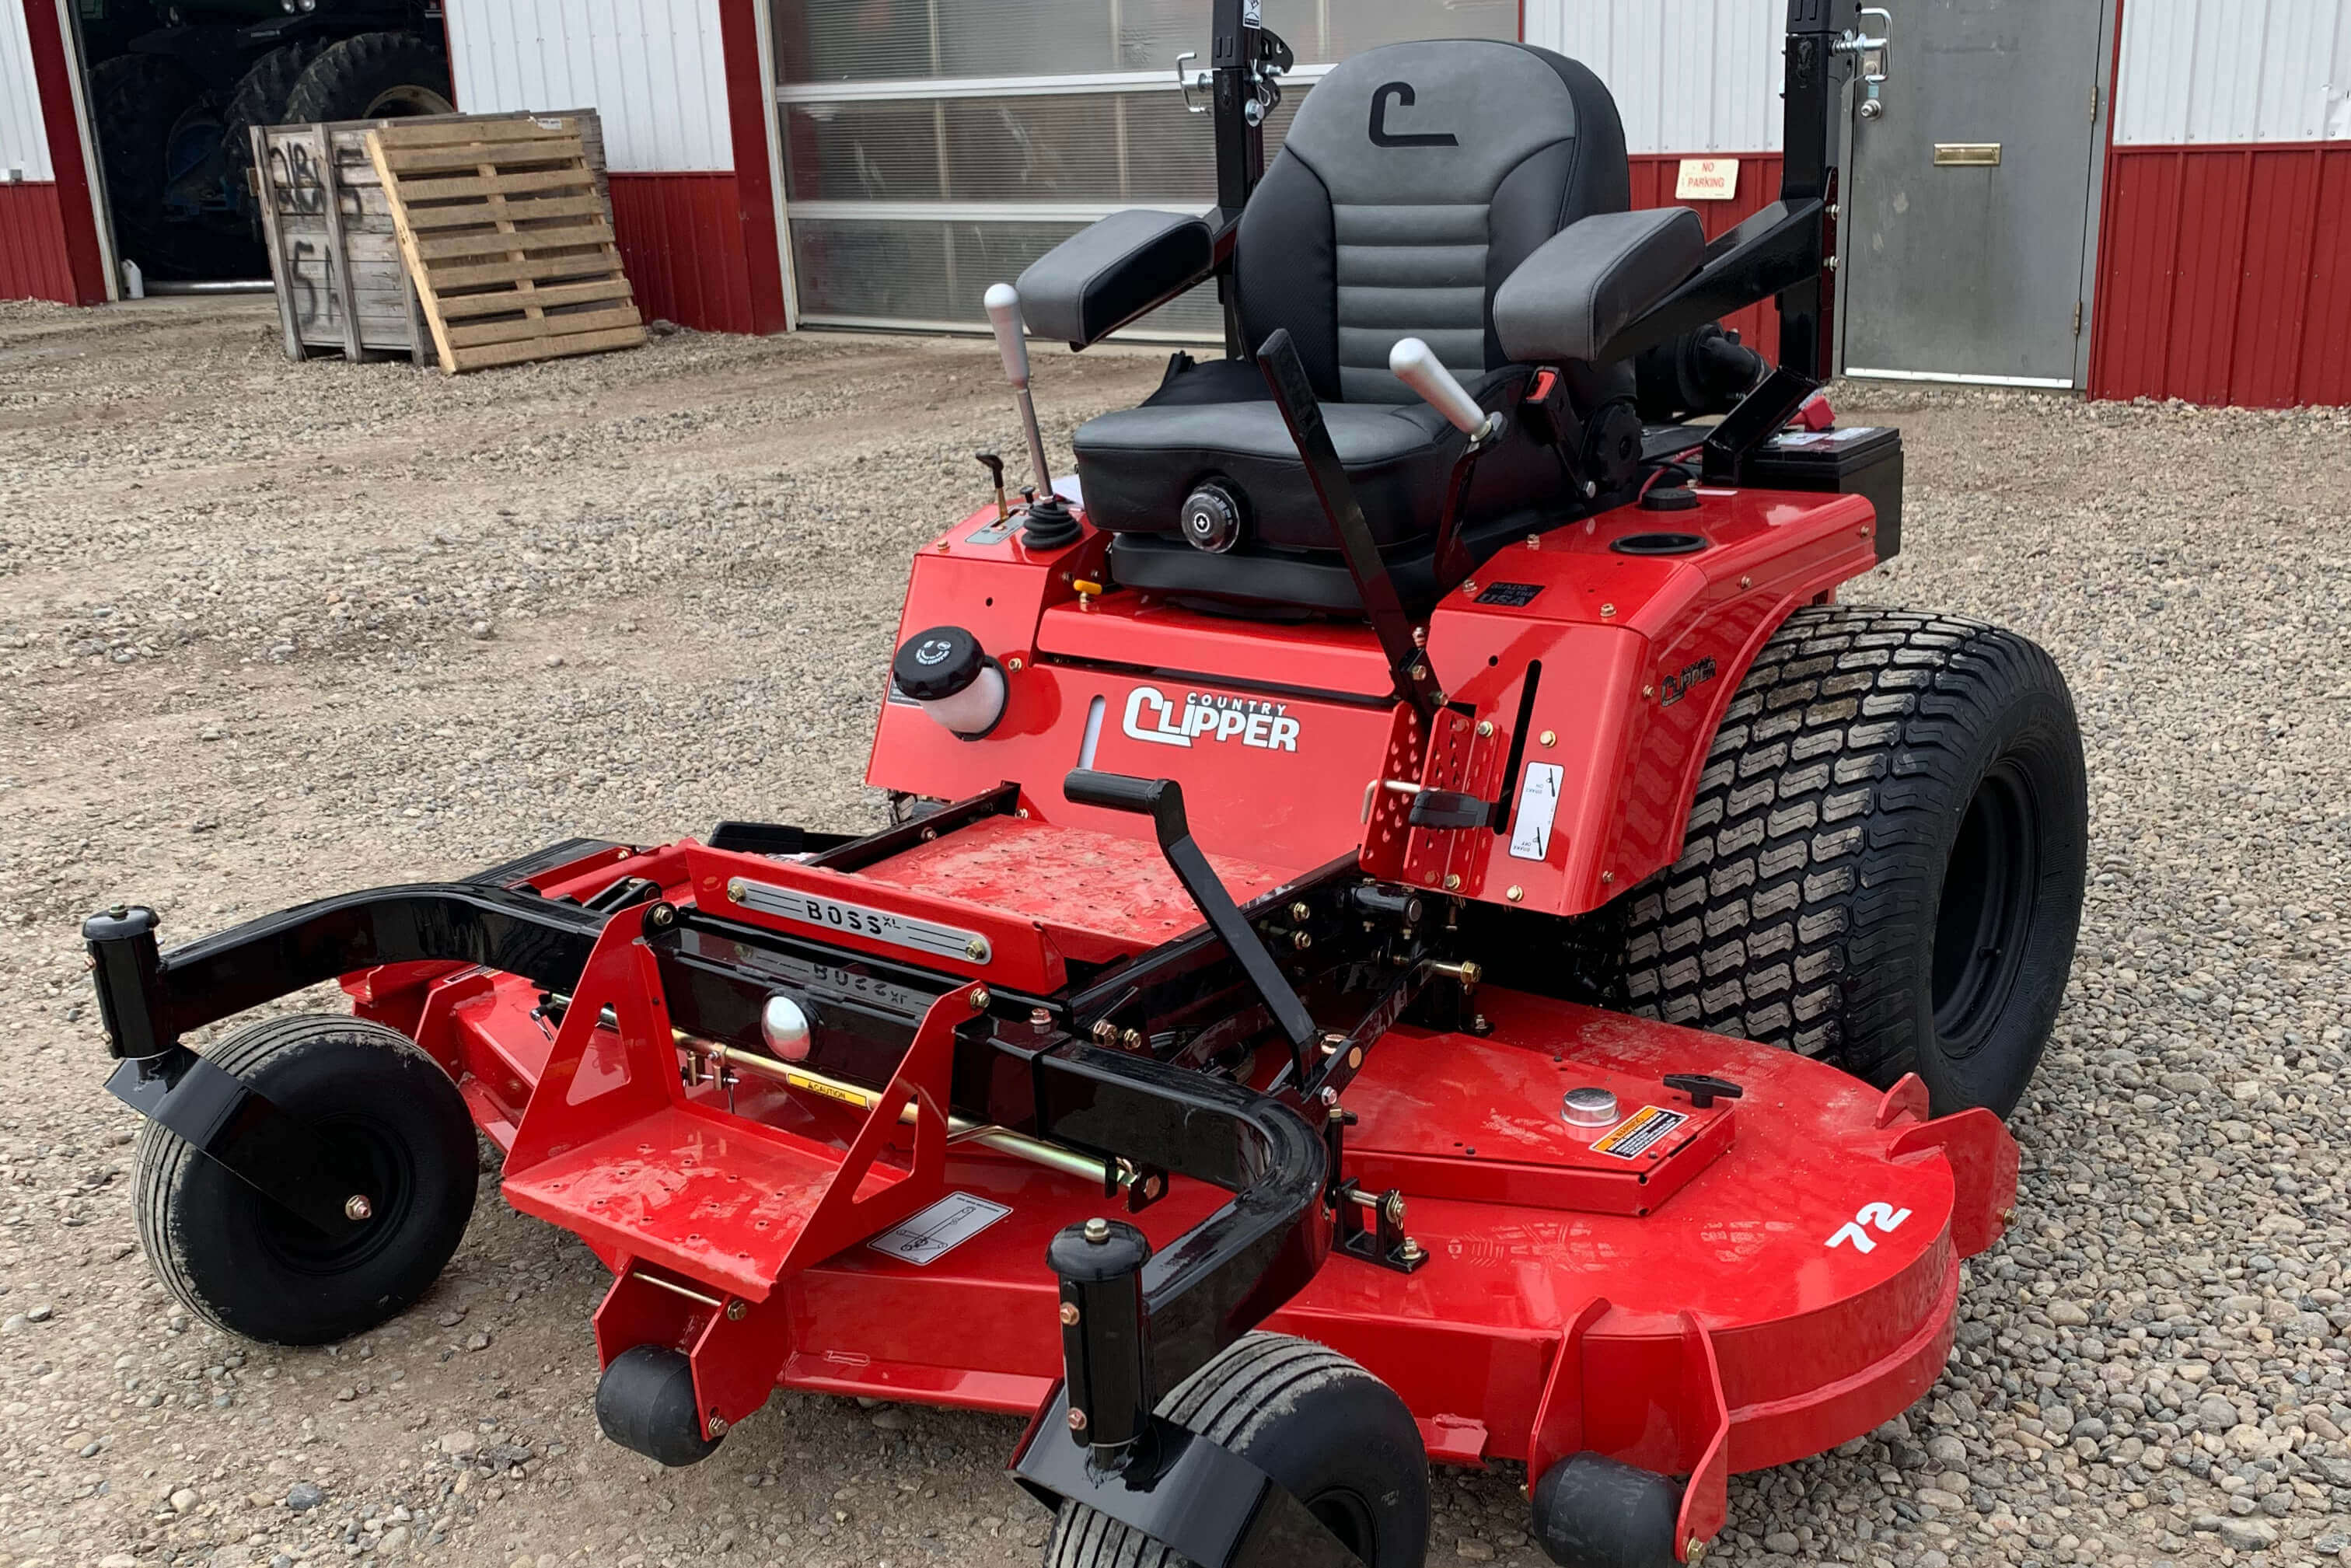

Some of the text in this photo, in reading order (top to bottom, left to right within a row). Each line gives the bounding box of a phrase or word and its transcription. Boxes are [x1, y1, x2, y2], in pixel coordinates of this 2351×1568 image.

[1702, 162, 1714, 172] NO
[1688, 177, 1725, 187] PARKING
[1186, 692, 1287, 717] COUNTRY
[1123, 686, 1301, 753] CLIPPER
[806, 900, 902, 934] BOSS XL
[813, 1084, 846, 1099] CAUTION
[1824, 1202, 1913, 1254] 72
